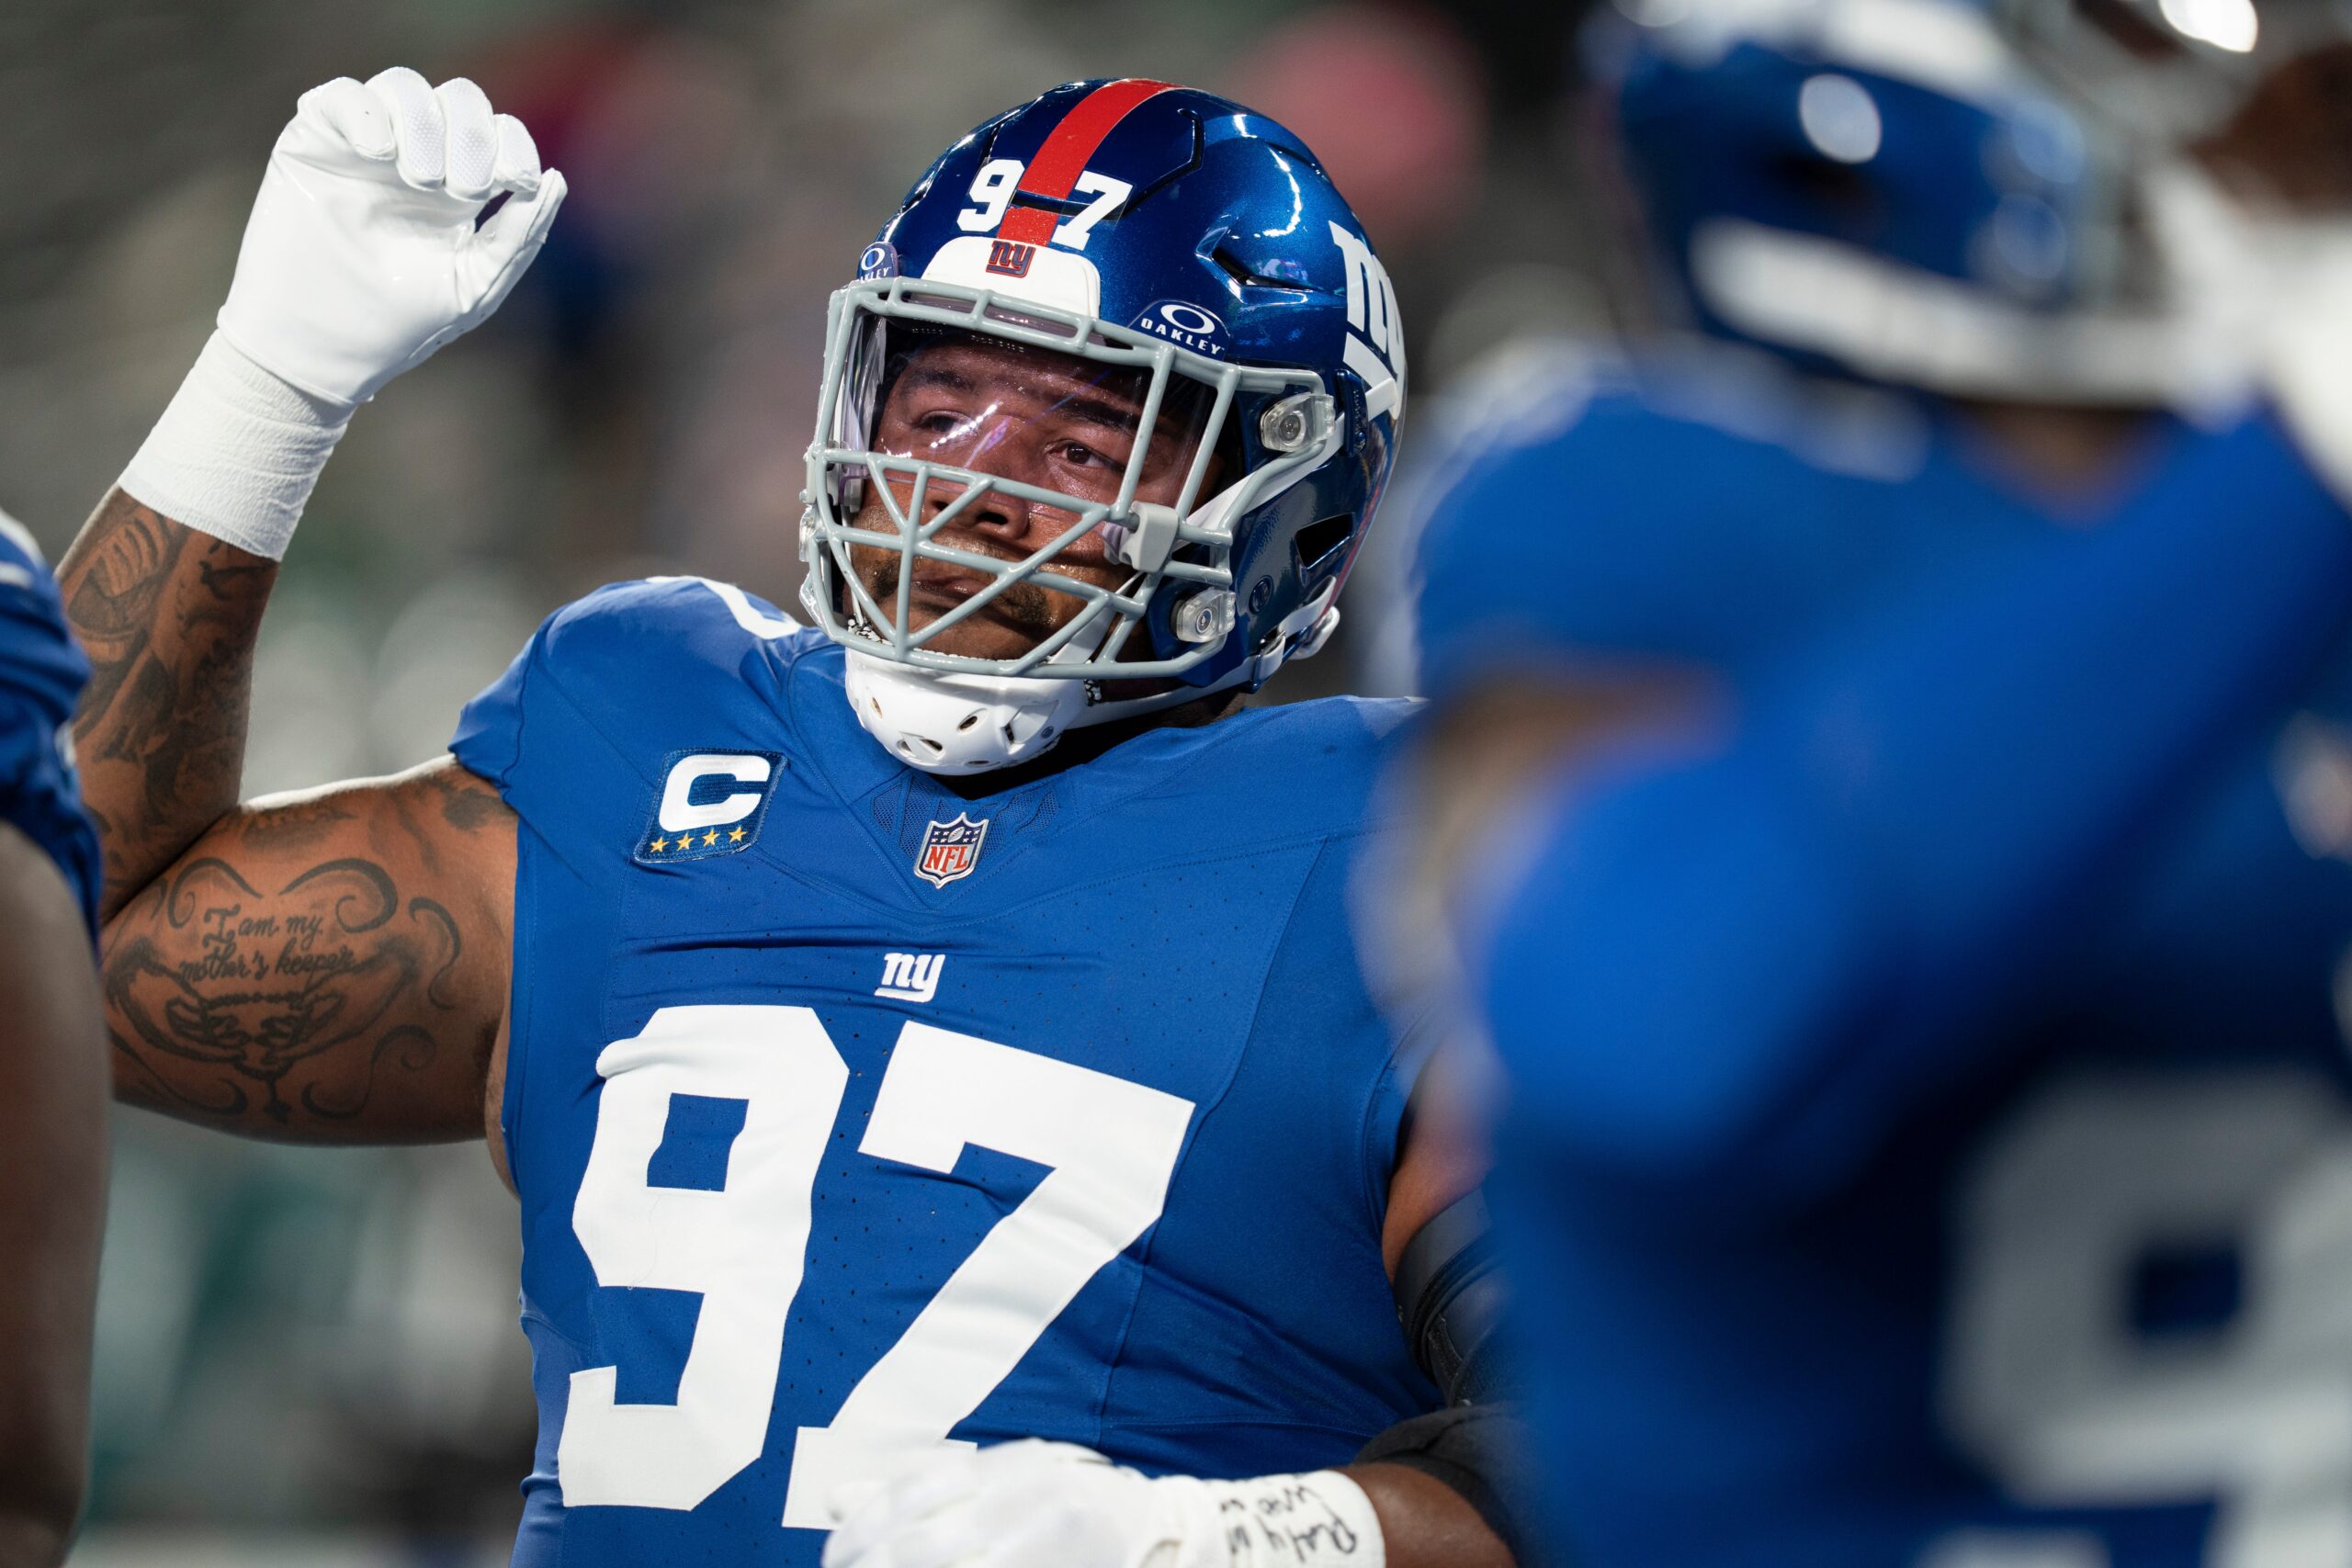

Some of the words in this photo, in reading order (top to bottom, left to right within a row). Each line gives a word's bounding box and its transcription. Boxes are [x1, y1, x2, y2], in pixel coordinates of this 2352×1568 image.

[956, 159, 1133, 251] 97
[1140, 318, 1222, 355] OAKLEY
[659, 754, 771, 832] C
[923, 843, 969, 874] NFL
[239, 916, 279, 938] am
[286, 915, 323, 951] my
[875, 952, 946, 1003] ny
[557, 1003, 1196, 1532] 97
